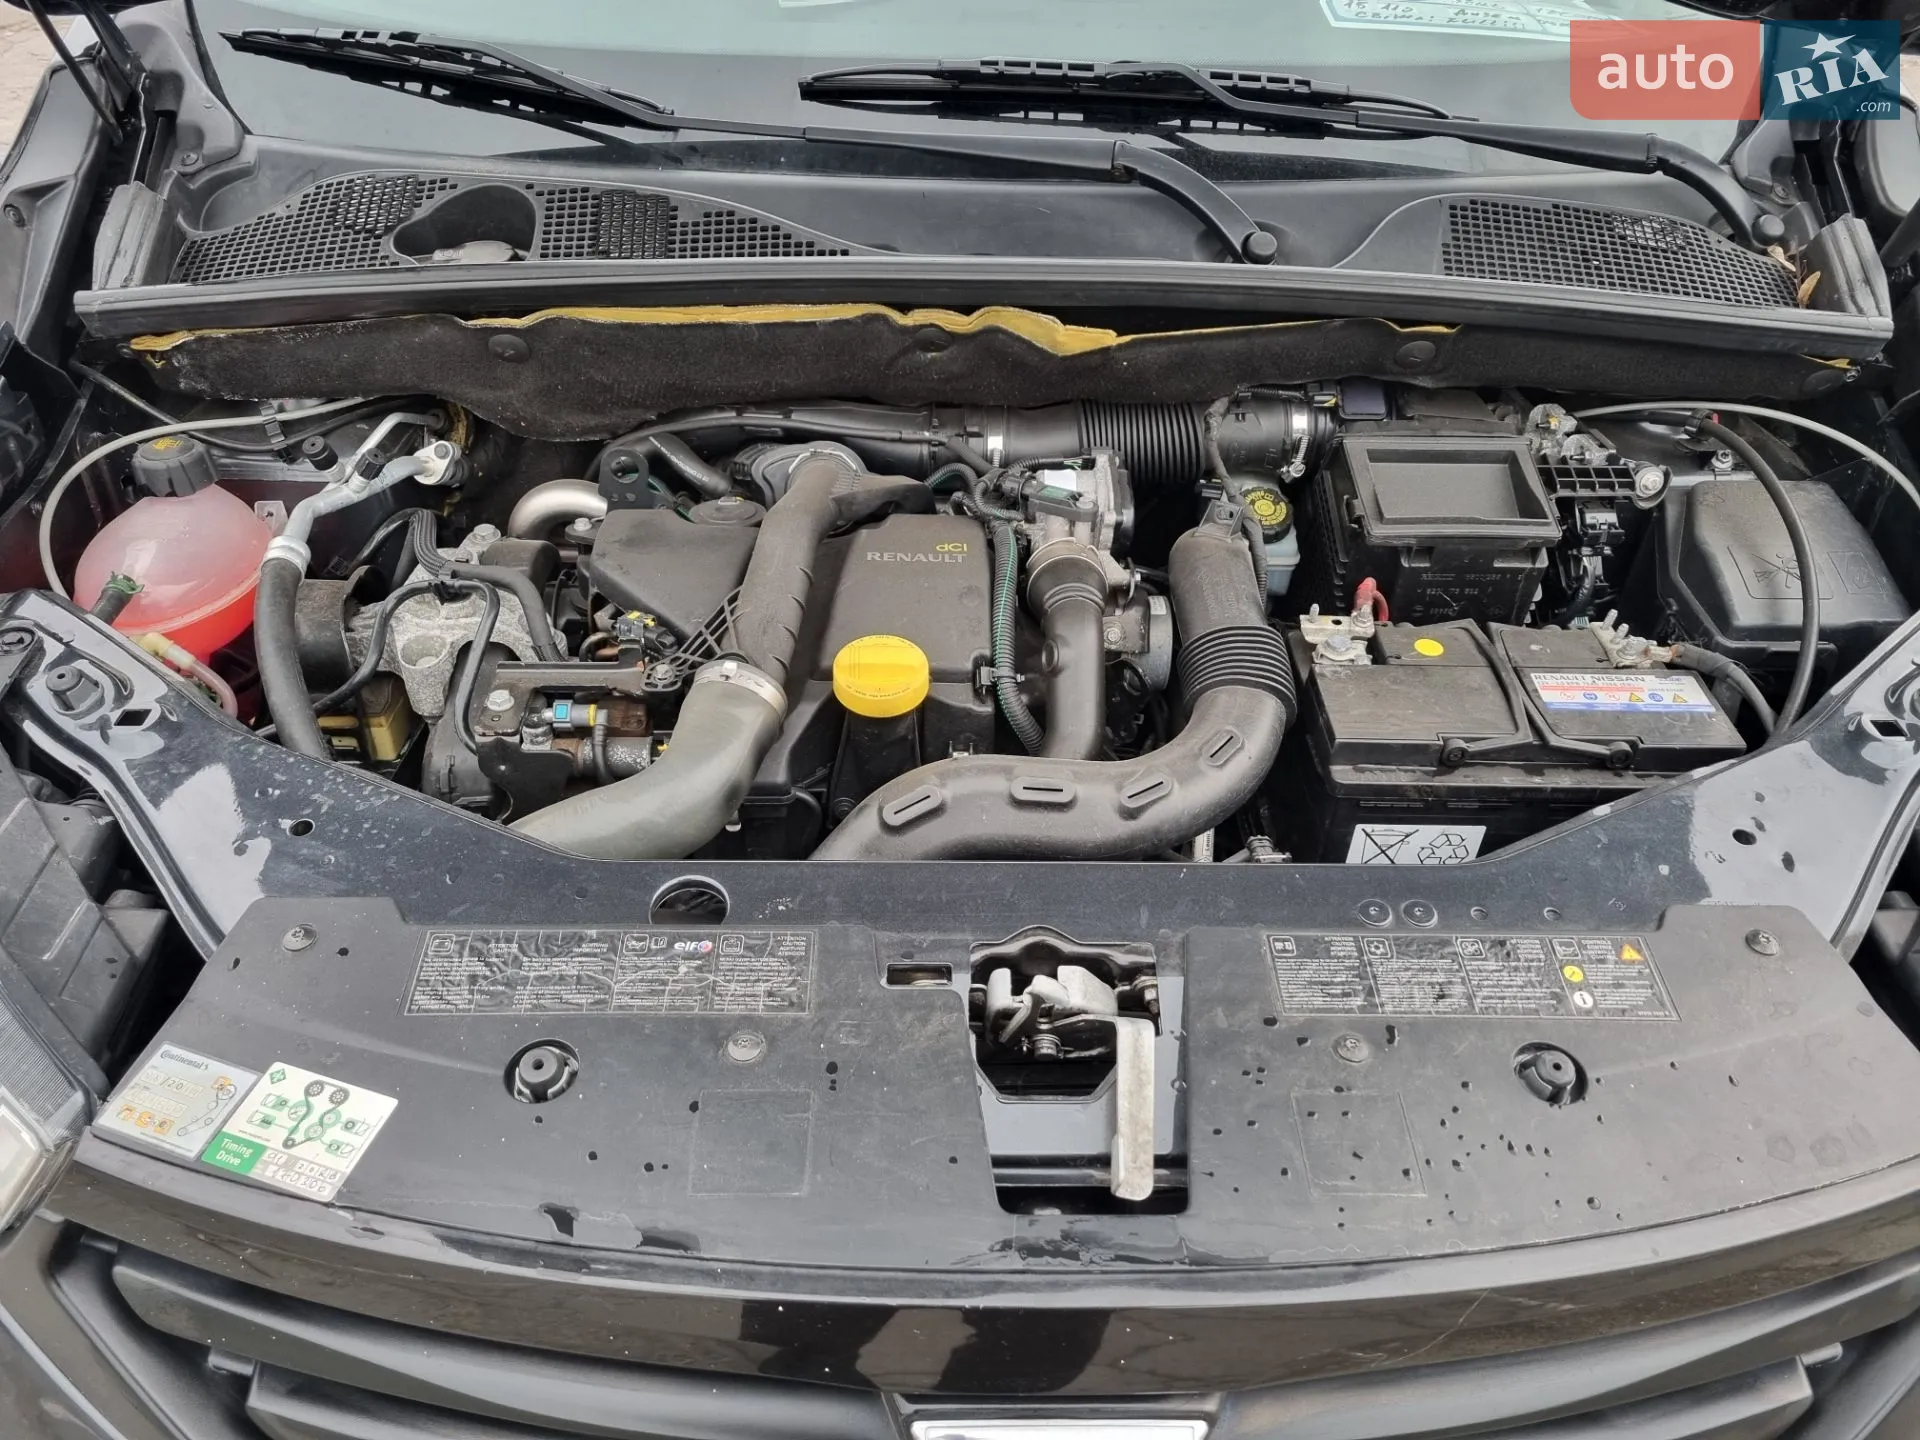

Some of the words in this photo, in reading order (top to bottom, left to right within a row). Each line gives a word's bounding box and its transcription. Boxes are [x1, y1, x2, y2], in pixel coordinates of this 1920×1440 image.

[866, 551, 967, 563] RENAULT
[1534, 674, 1586, 682] RENAULT
[674, 941, 698, 951] elf
[221, 1138, 254, 1158] Timing
[216, 1150, 242, 1166] Drive
